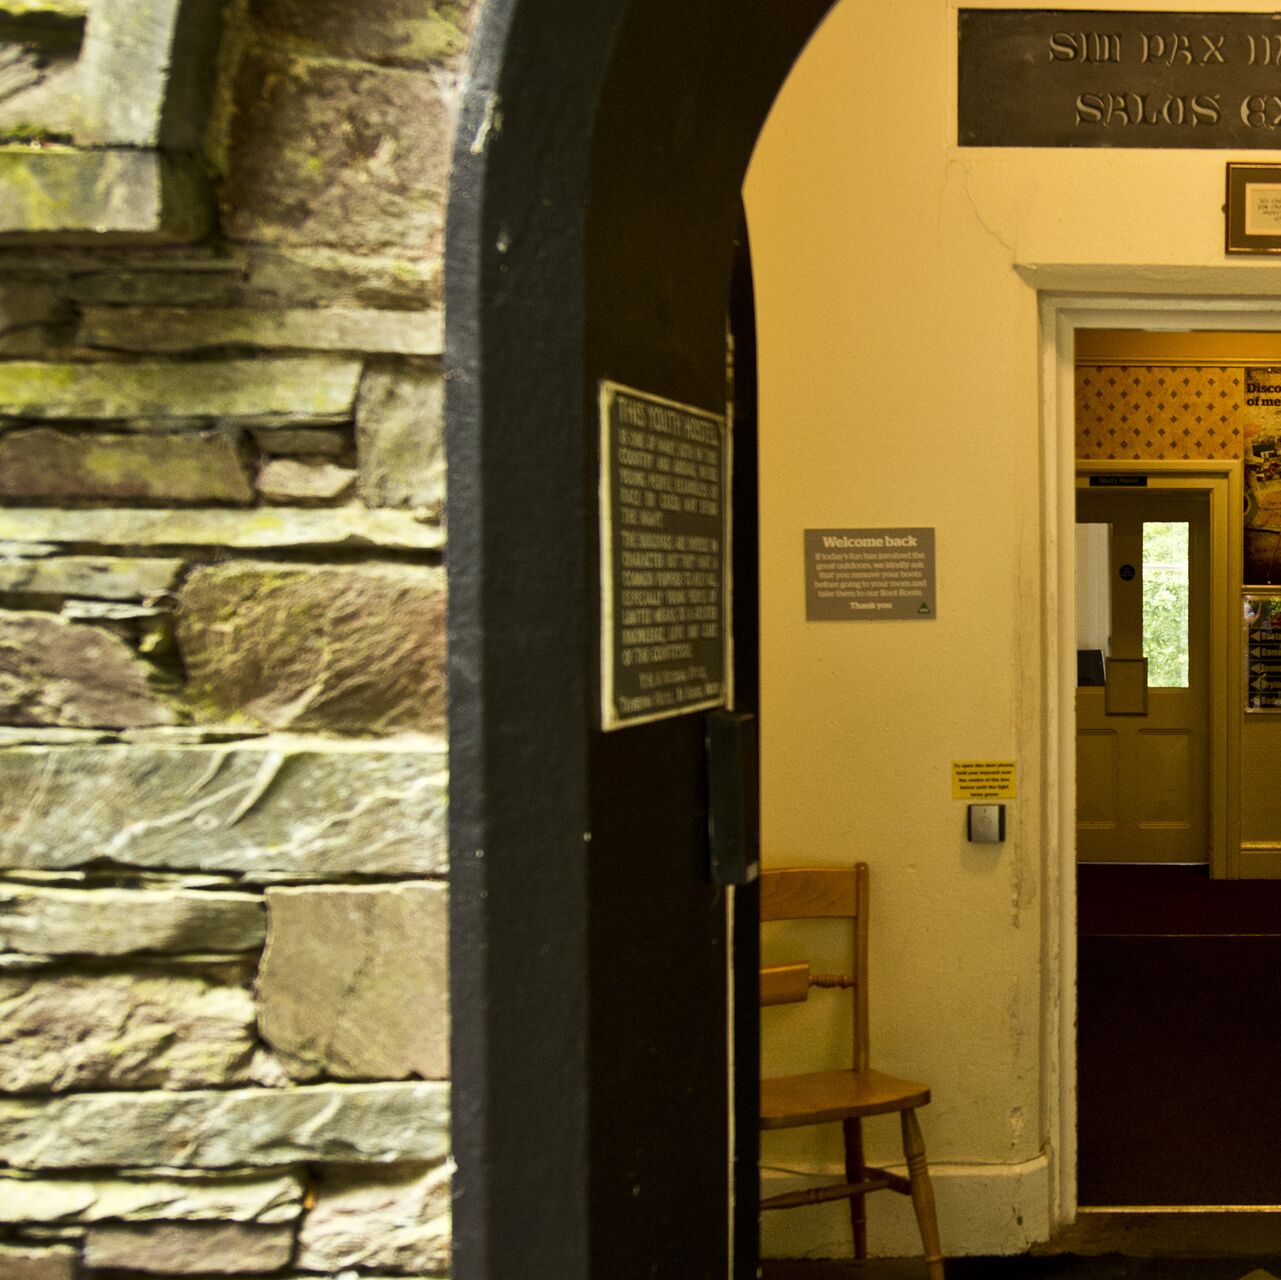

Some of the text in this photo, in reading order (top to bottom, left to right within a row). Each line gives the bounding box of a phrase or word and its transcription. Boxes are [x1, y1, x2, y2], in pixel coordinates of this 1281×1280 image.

[1138, 32, 1226, 66] PAX
[1247, 397, 1259, 406] of
[617, 395, 646, 428] THIS
[647, 404, 679, 436] YOUTH
[823, 536, 917, 548] Welcome back
[850, 602, 892, 610] Thank you
